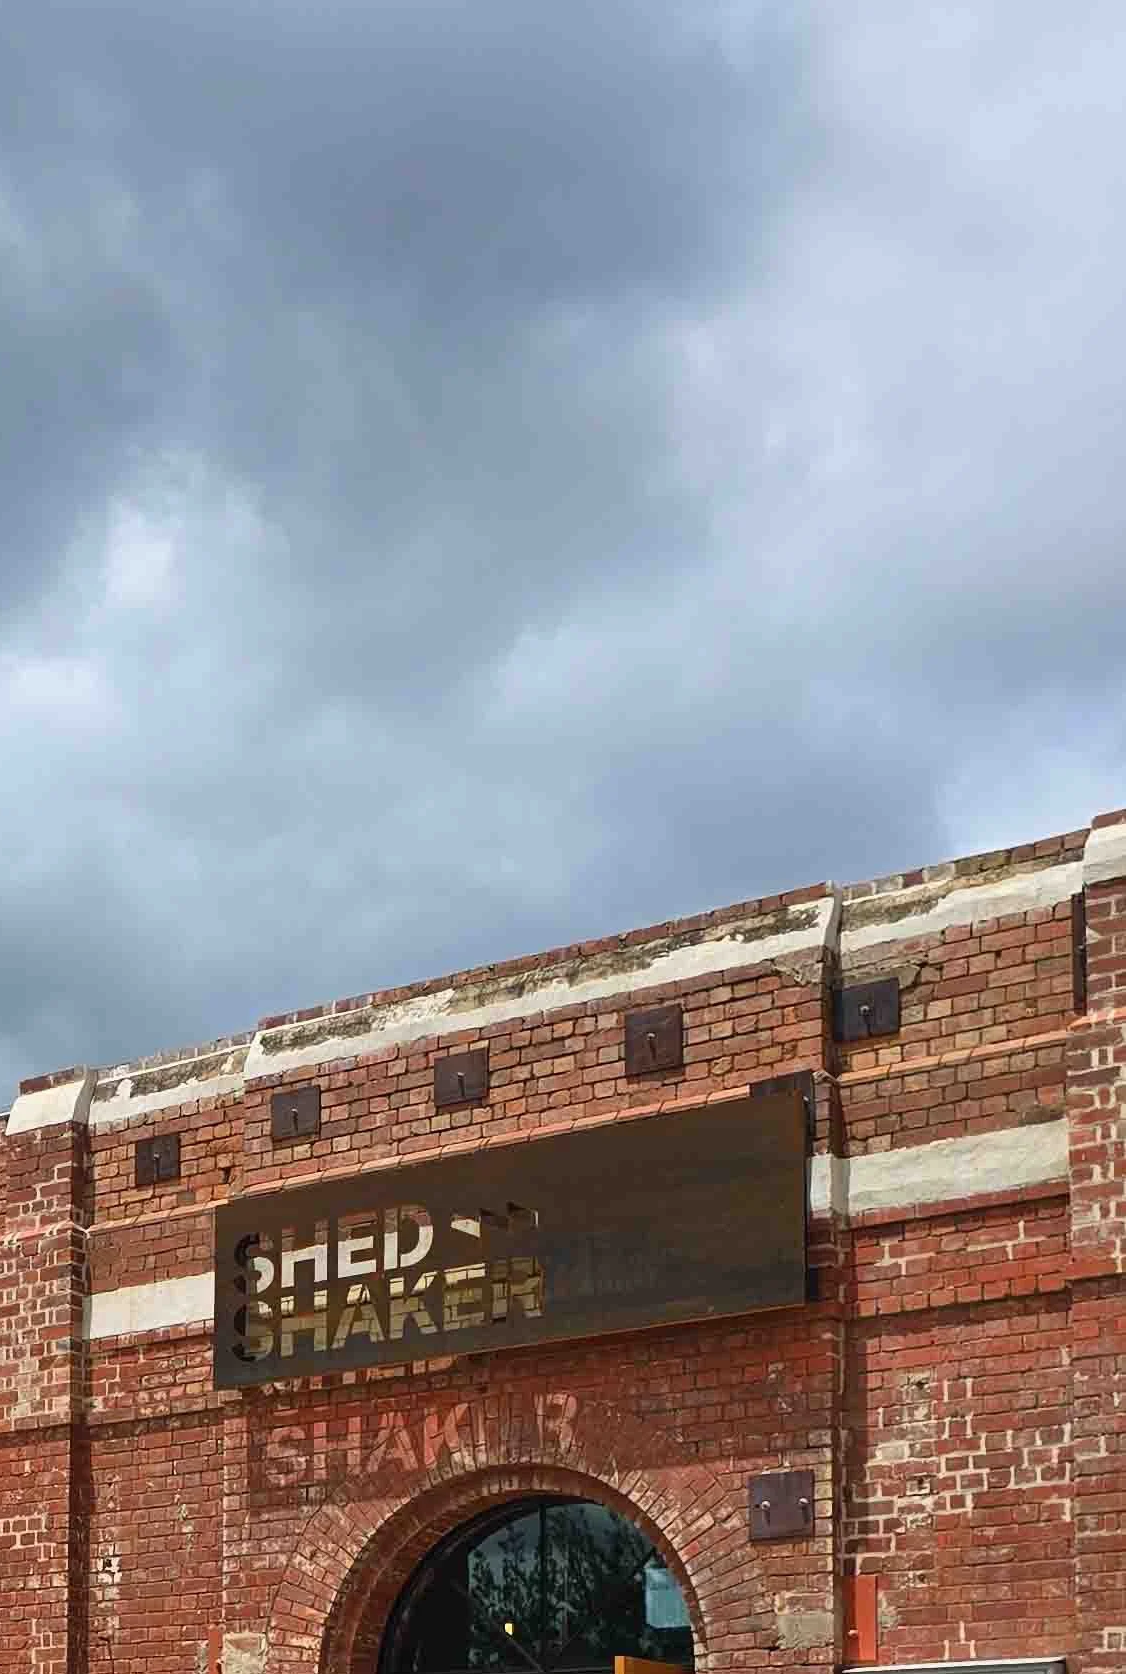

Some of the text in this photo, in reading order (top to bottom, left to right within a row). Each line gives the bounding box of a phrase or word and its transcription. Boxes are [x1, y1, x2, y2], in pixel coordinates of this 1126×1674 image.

[234, 1204, 434, 1295] SHED
[231, 1255, 545, 1363] SHAKER
[266, 1390, 577, 1488] SHAKR
